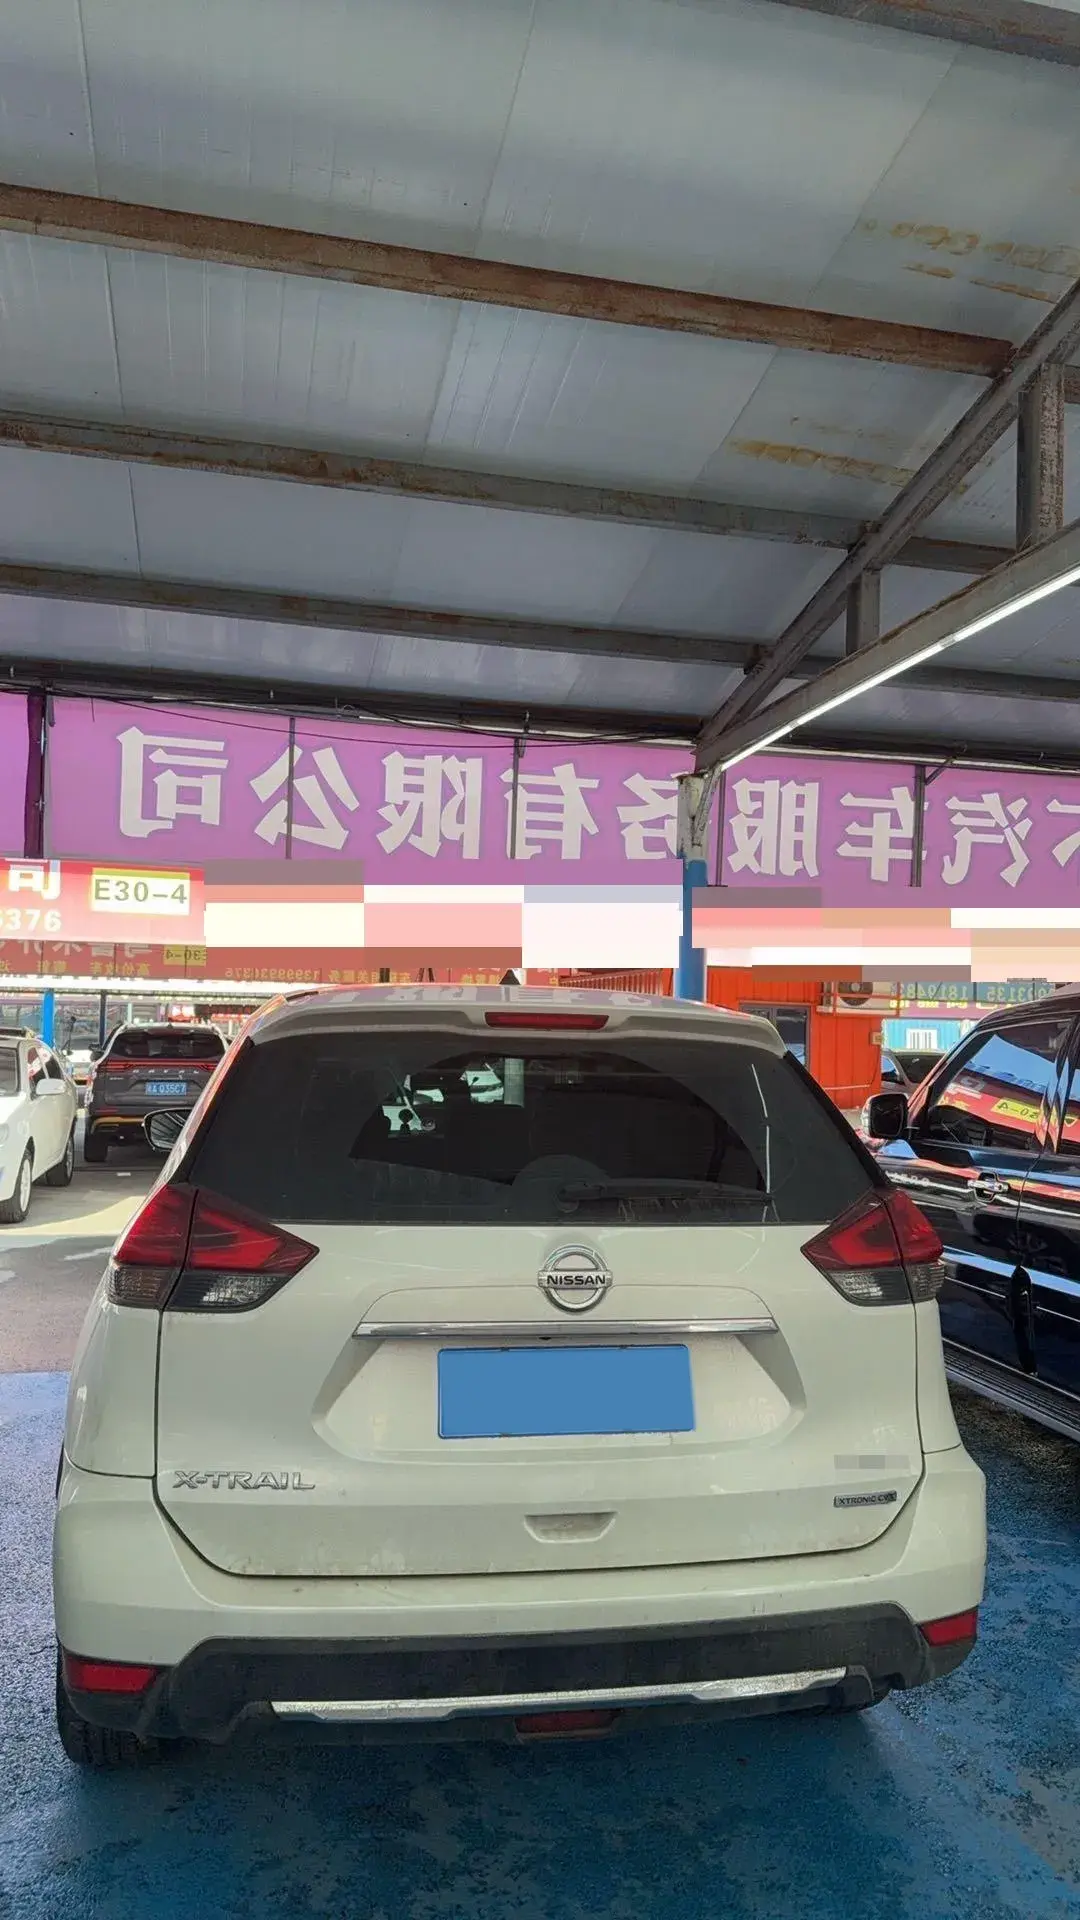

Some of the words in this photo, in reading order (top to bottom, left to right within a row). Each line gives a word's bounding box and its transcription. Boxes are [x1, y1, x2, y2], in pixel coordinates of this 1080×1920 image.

[94, 878, 188, 905] E30-4
[0, 908, 61, 932] 376
[547, 1275, 606, 1286] NISSAN
[172, 1471, 316, 1490] X-TRAIL
[839, 1495, 876, 1505] XTRONIC
